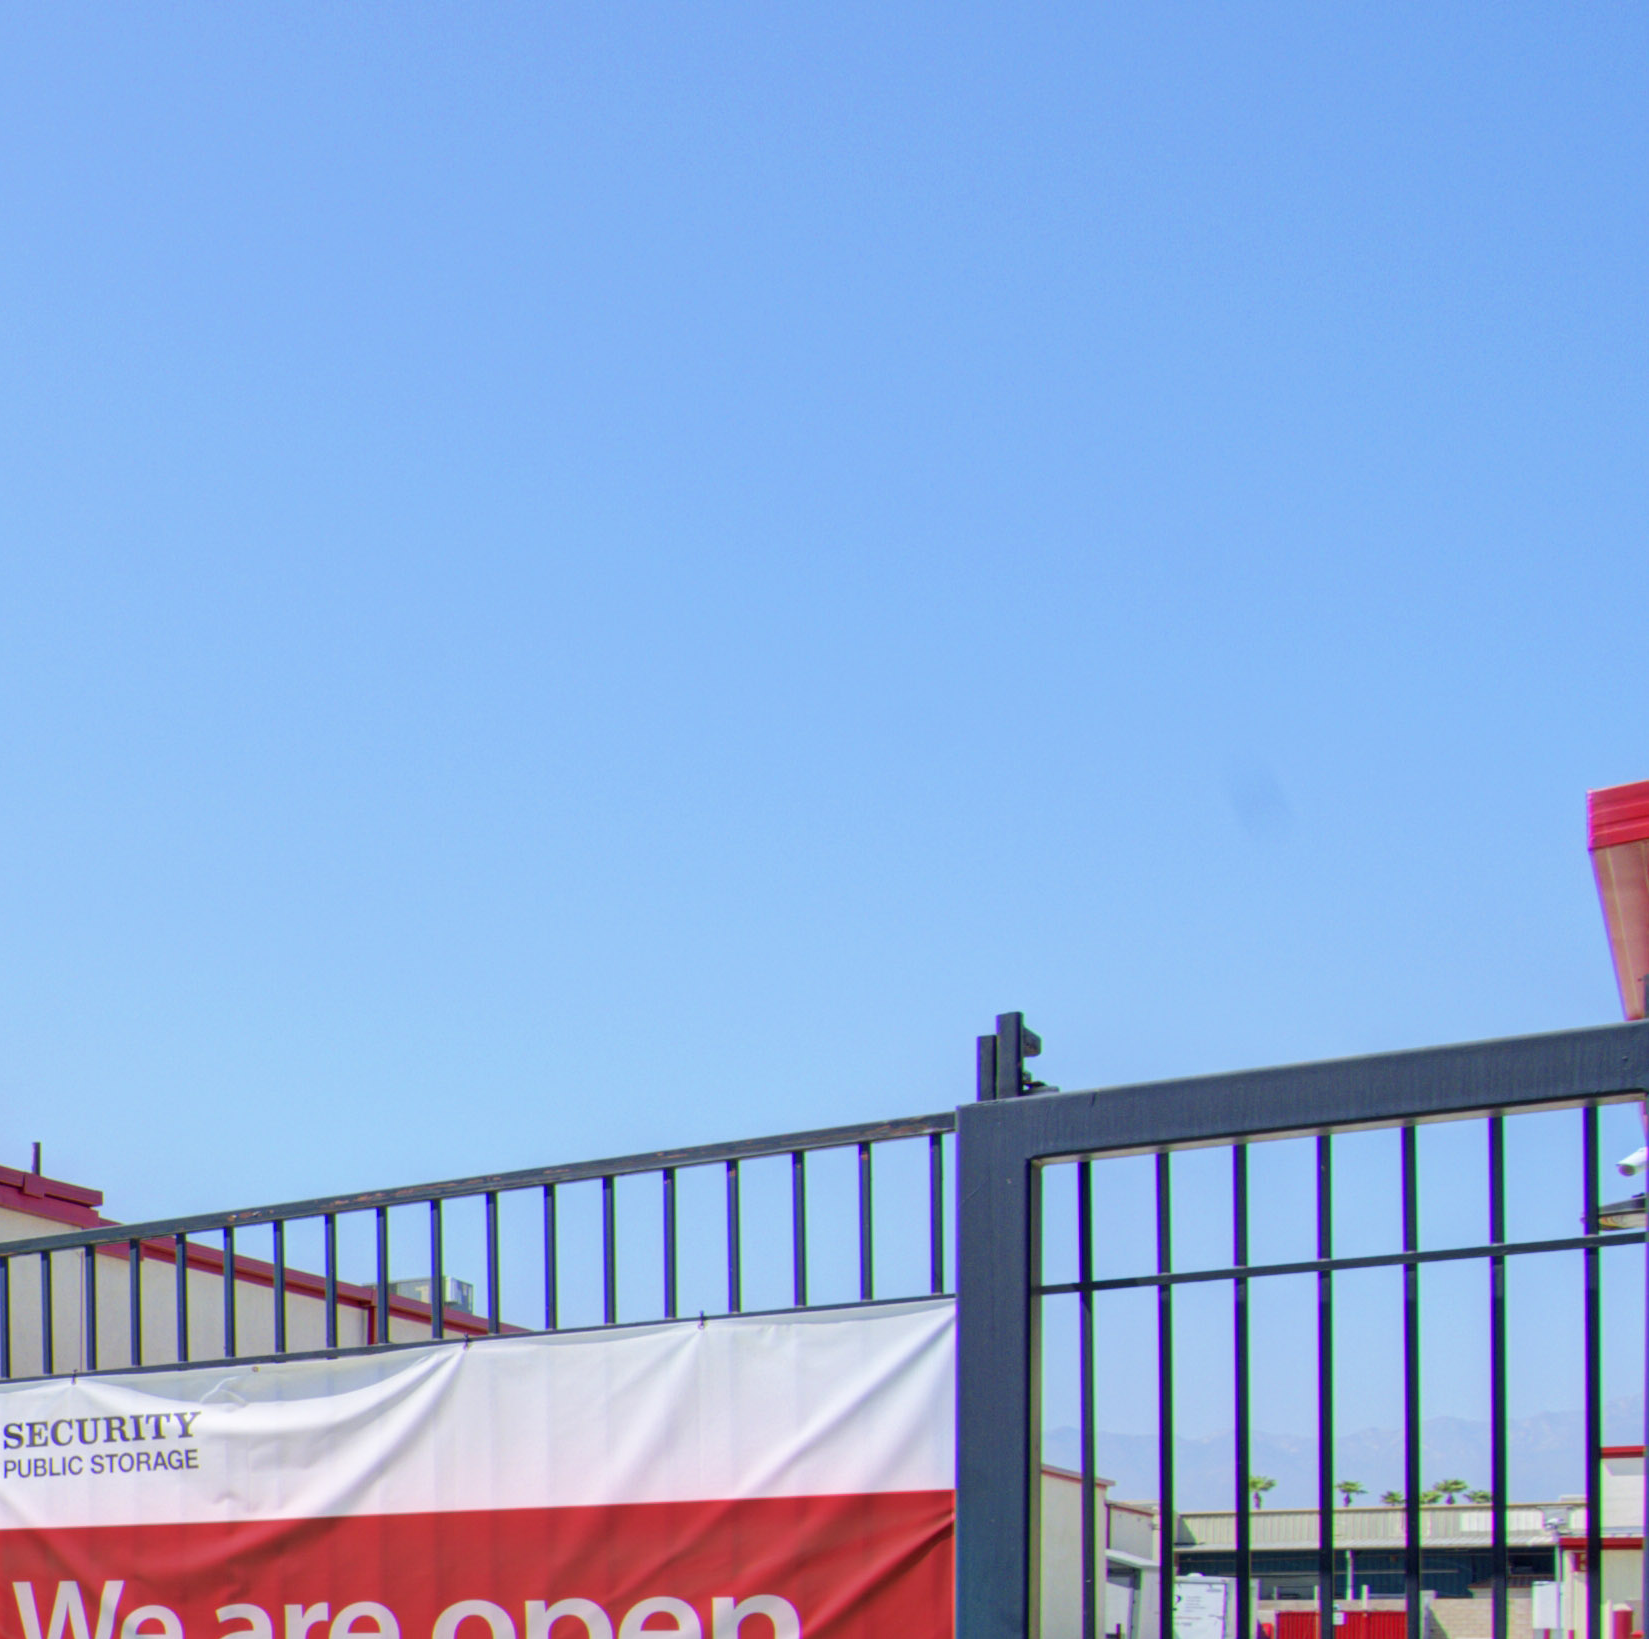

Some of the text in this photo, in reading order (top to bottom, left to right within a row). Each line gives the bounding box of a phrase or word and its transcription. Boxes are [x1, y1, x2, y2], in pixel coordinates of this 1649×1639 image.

[2, 1411, 201, 1450] SECURITY
[3, 1449, 199, 1479] PUBLIC STORAGE
